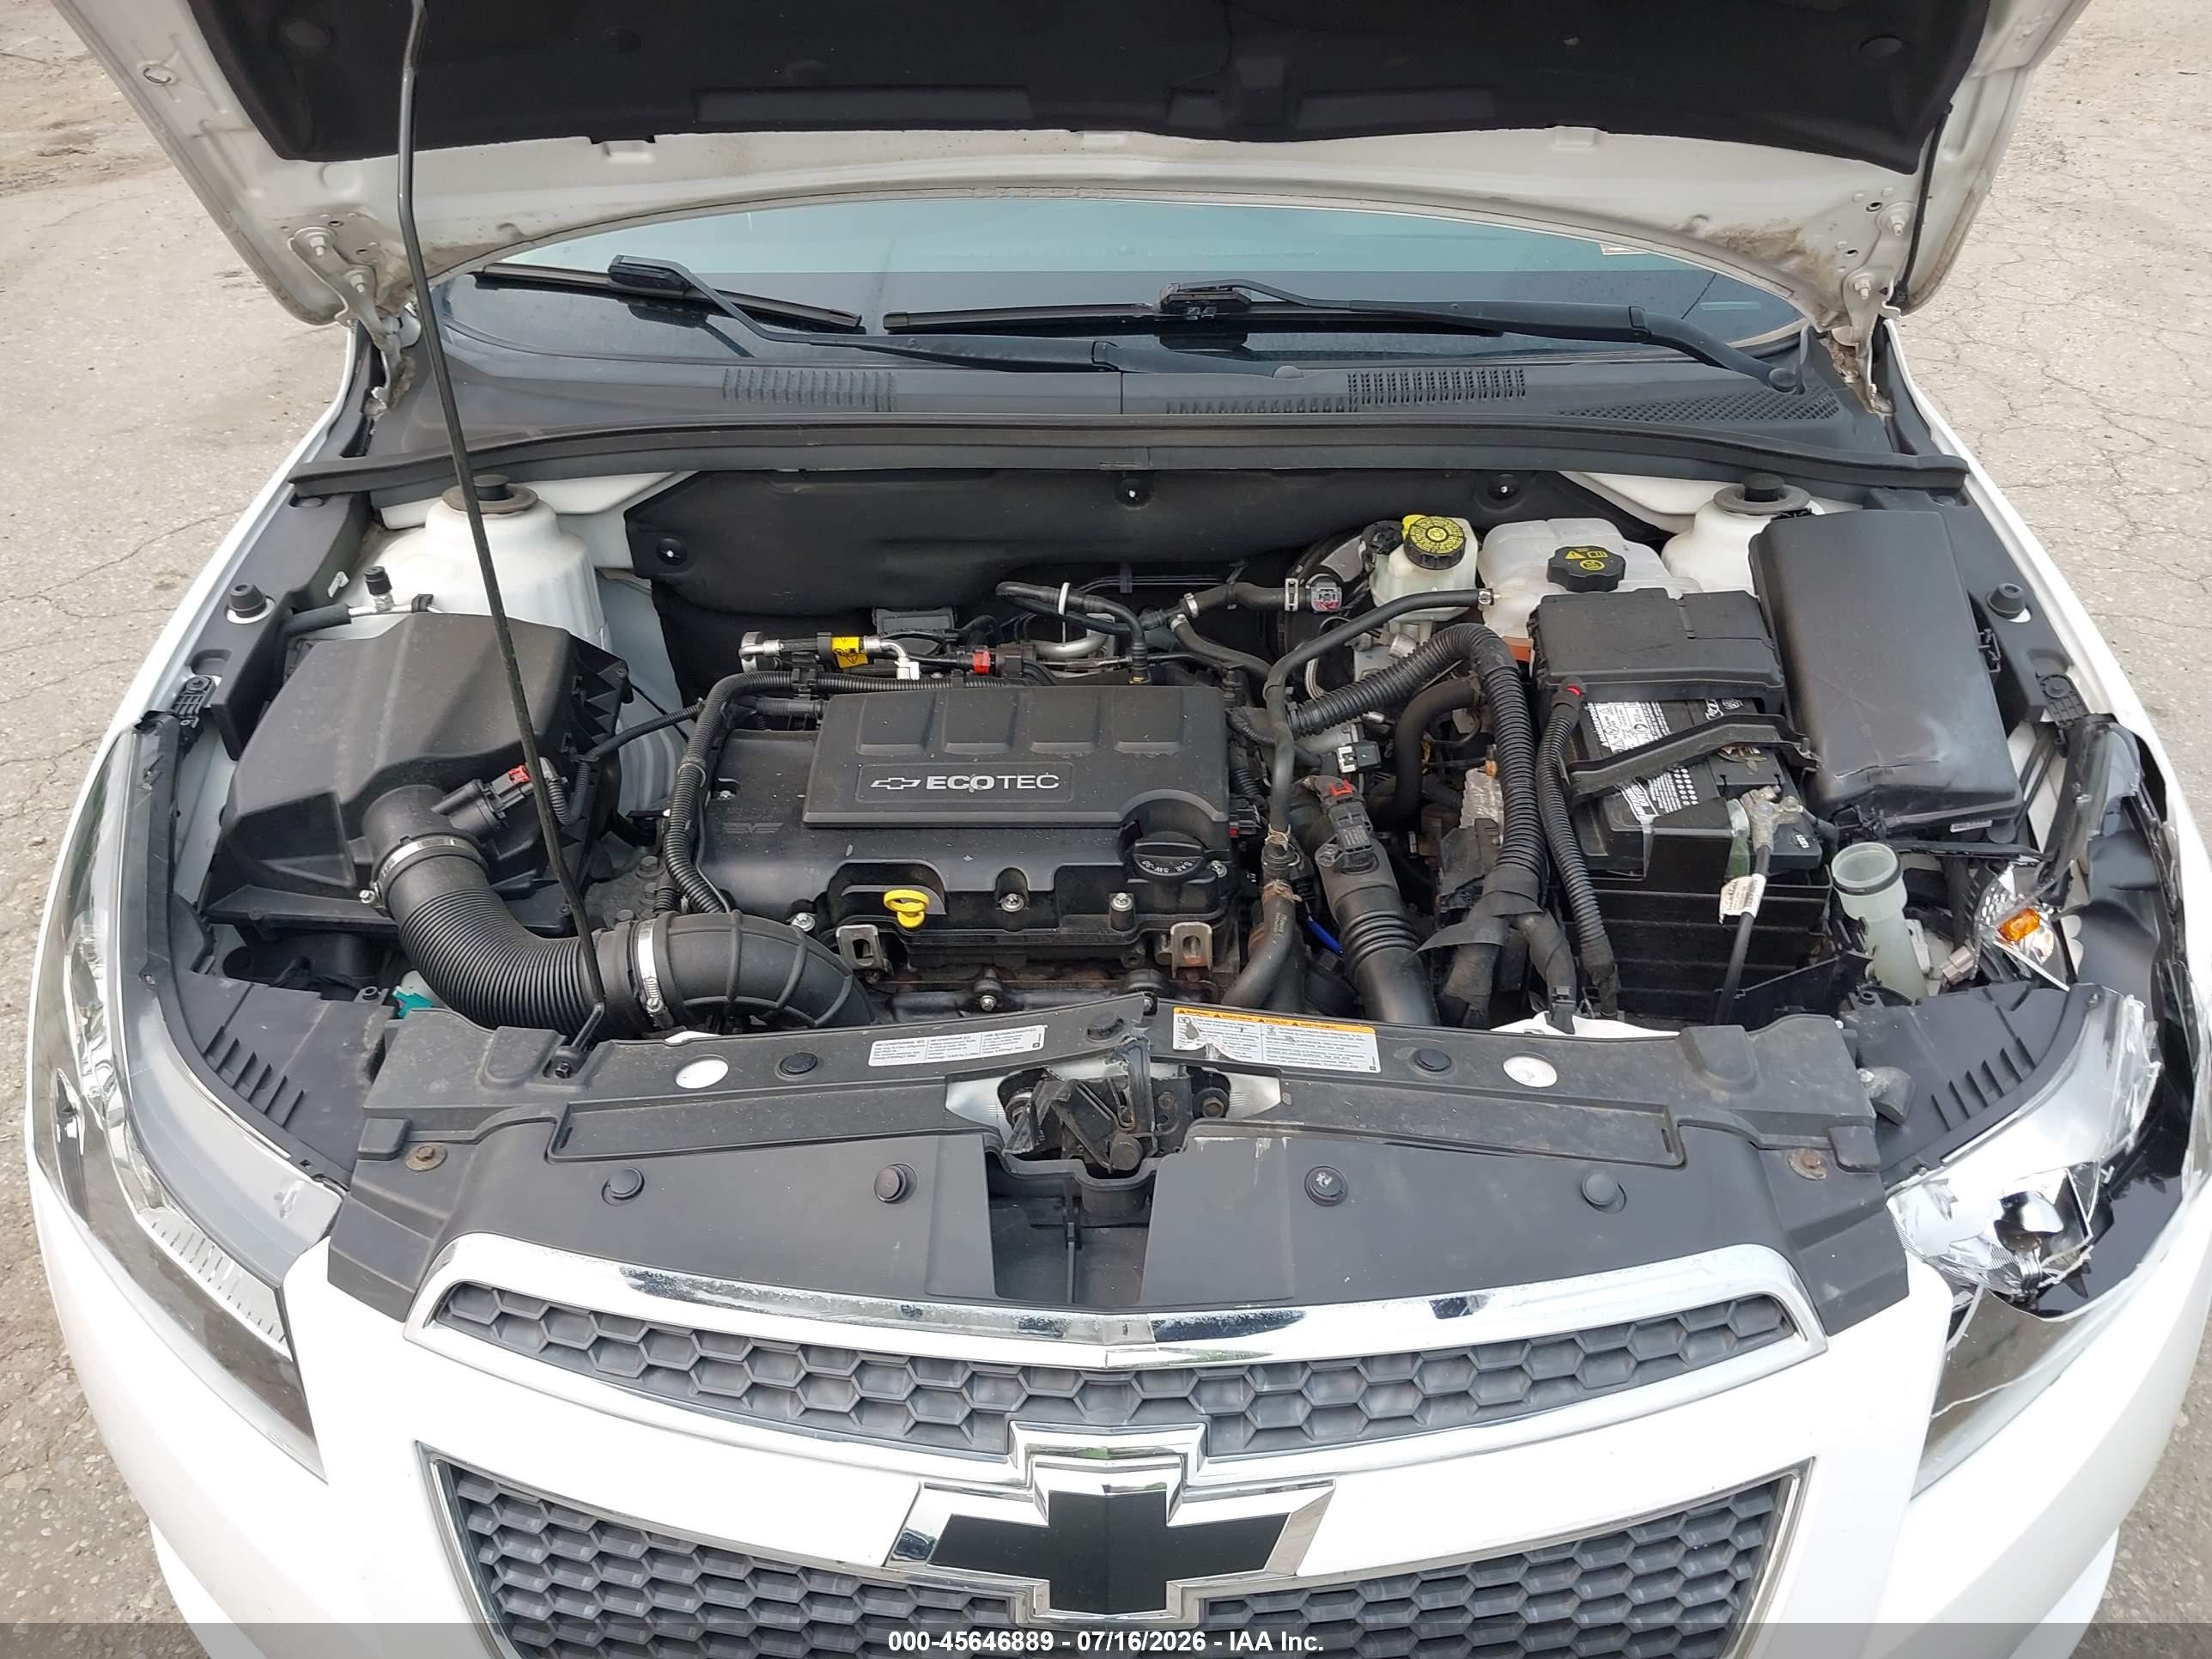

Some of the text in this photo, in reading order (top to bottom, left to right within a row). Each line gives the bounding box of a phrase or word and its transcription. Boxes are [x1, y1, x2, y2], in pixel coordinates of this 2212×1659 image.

[926, 774, 1060, 790] ECOTEC
[1141, 860, 1194, 873] SAE 5W-30
